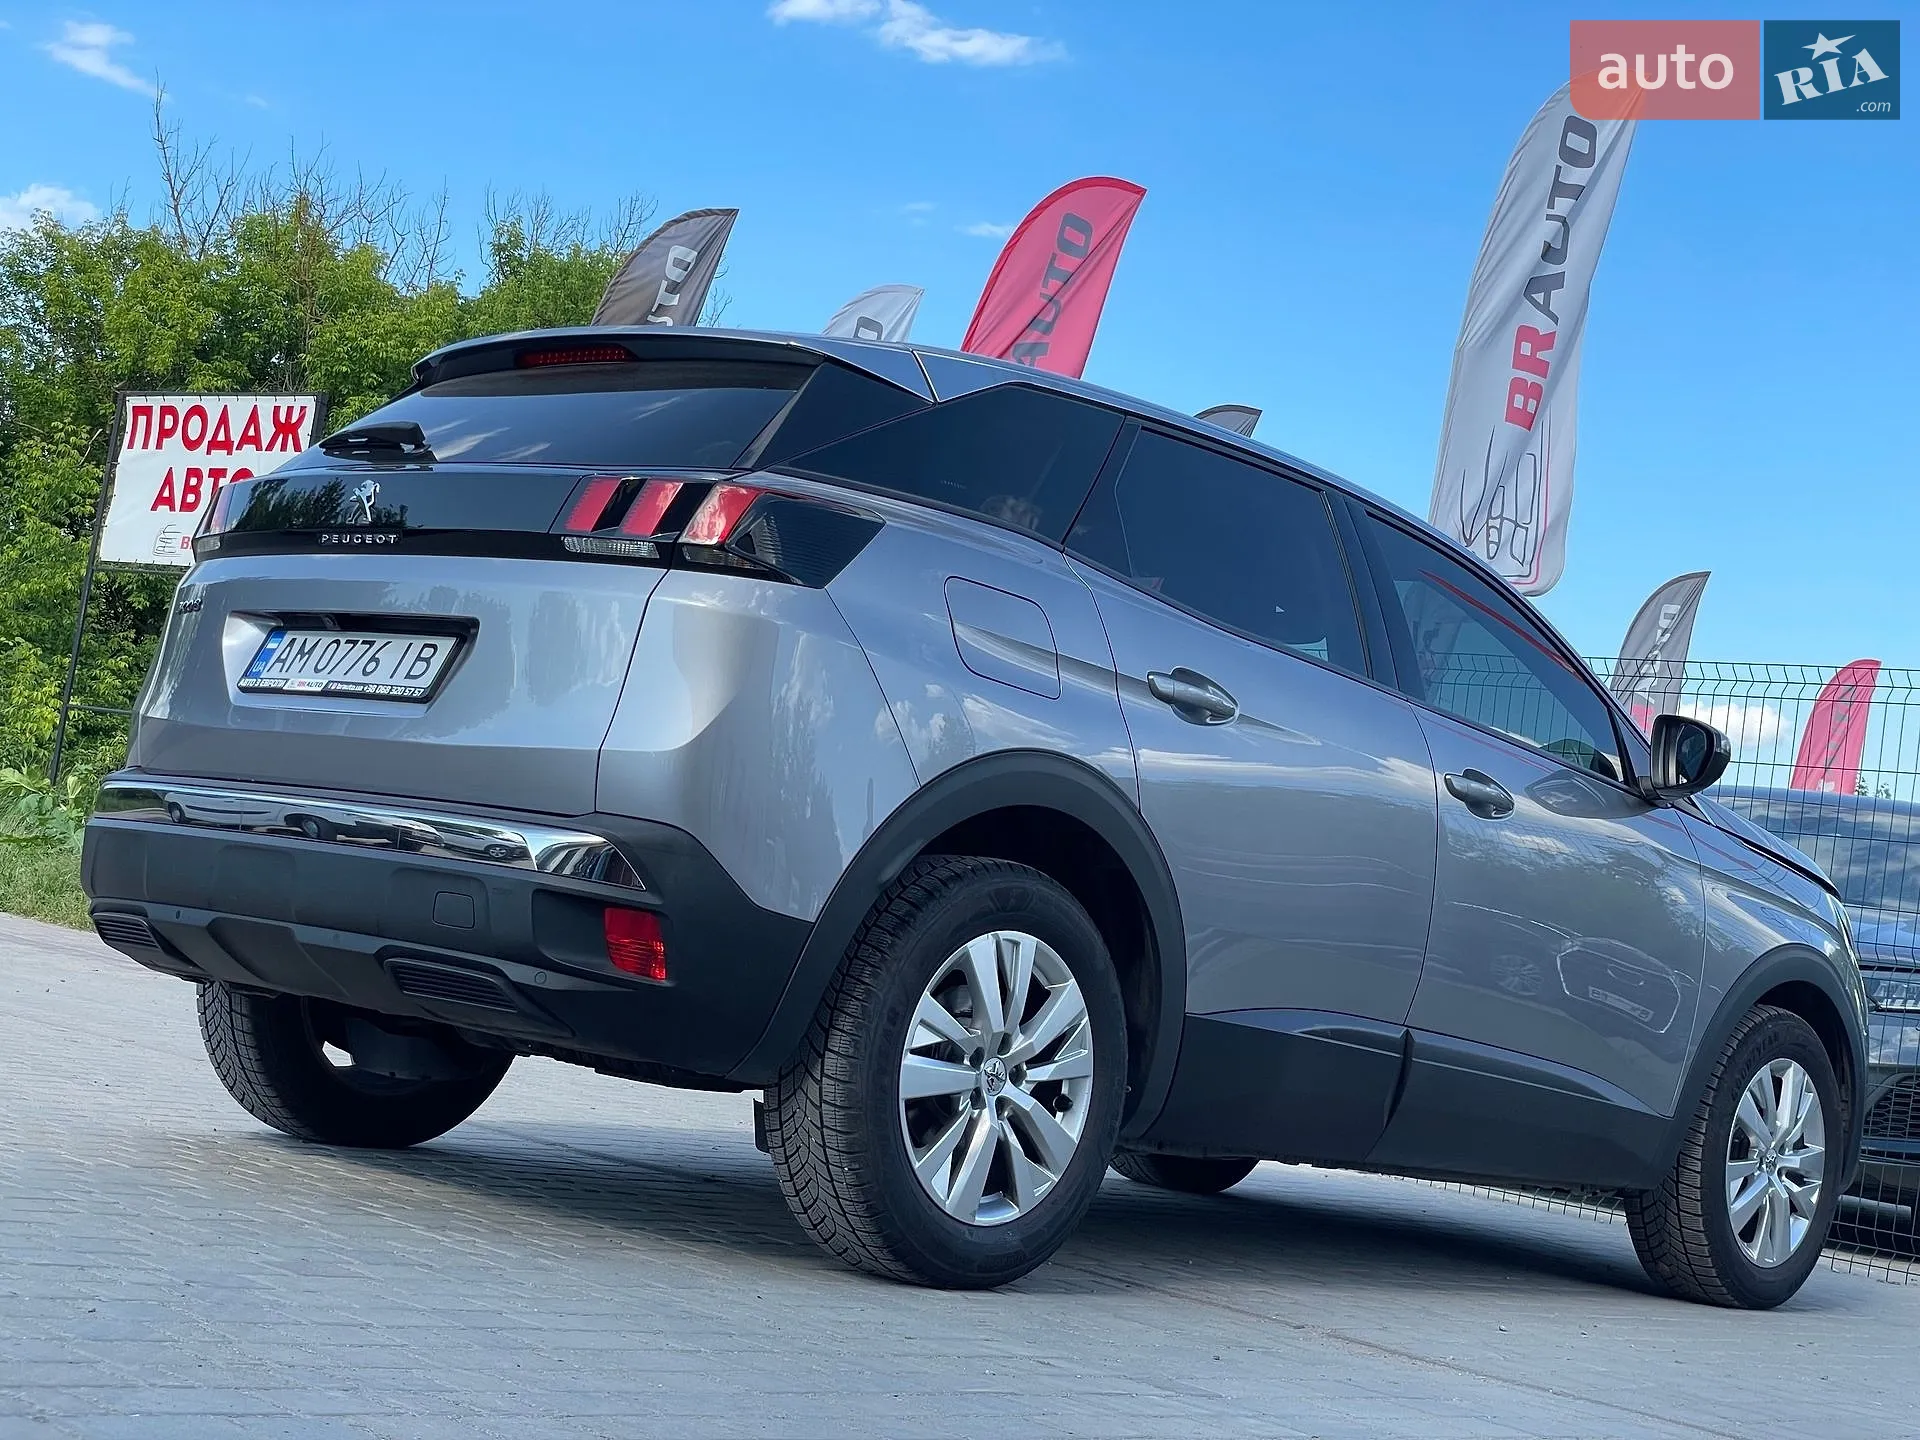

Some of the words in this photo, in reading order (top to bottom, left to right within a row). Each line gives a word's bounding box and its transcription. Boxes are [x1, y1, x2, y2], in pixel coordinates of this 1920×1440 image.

[127, 404, 307, 456] ПРОДАЖ
[150, 467, 255, 513] АВТ
[321, 534, 398, 544] PEUGEOT
[314, 638, 392, 677] 0776
